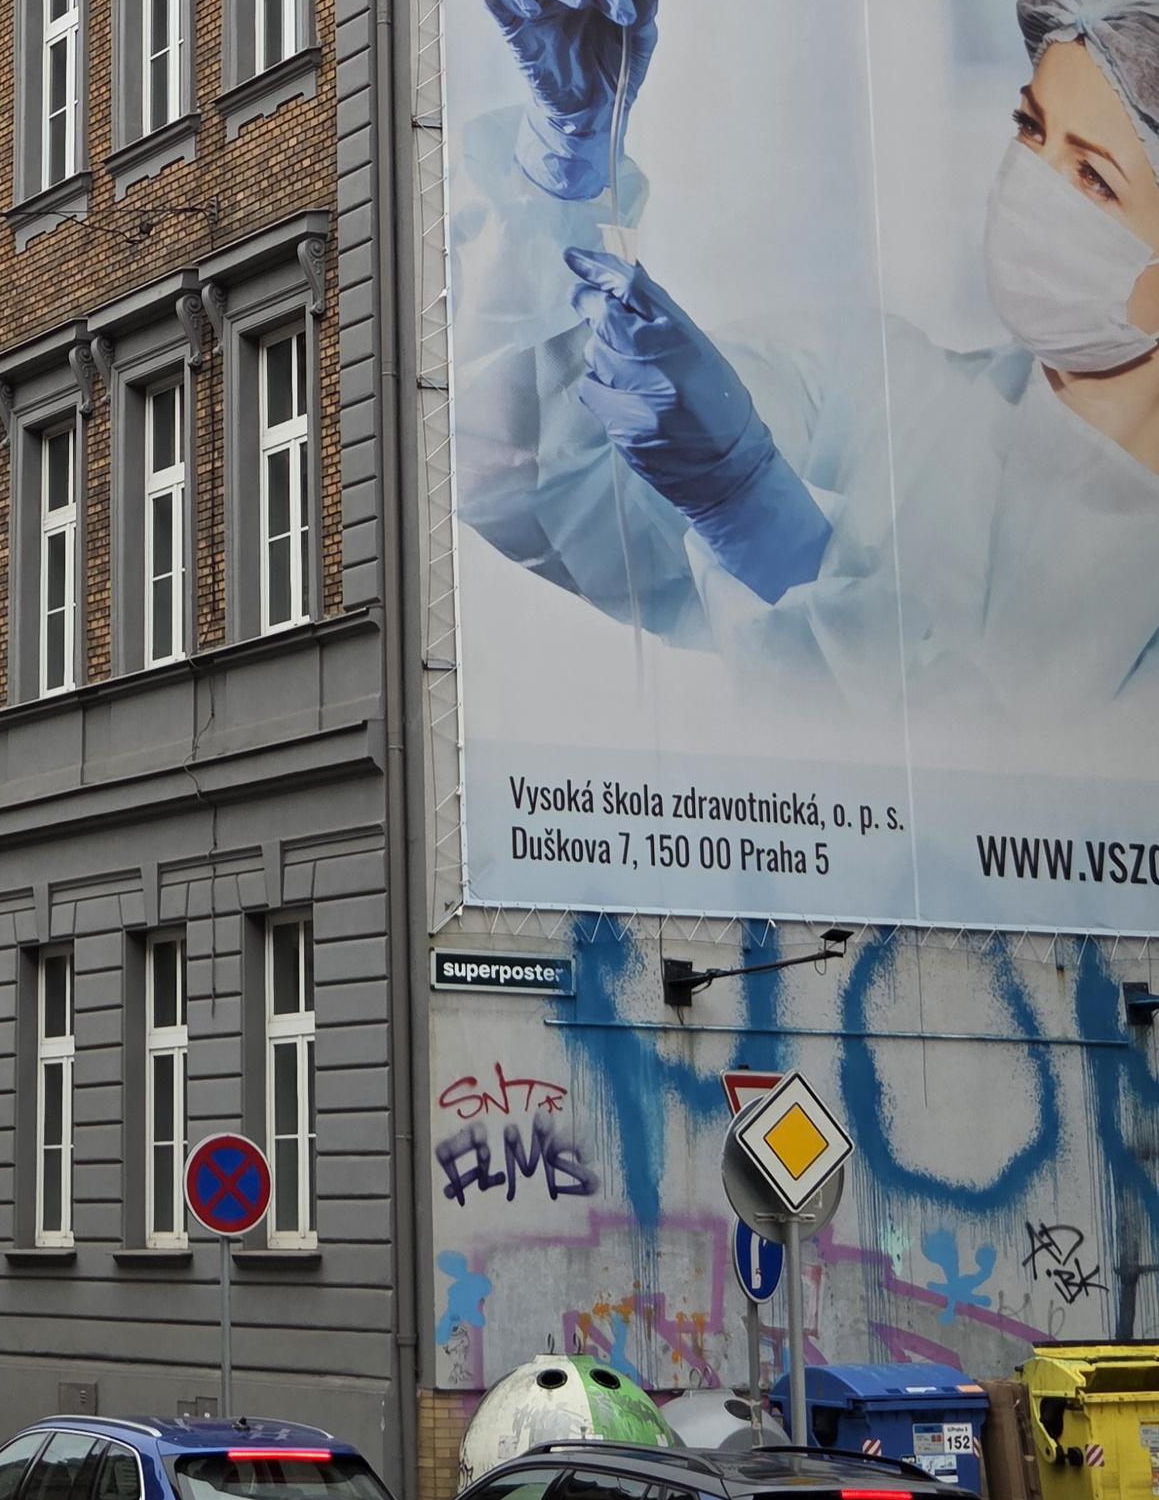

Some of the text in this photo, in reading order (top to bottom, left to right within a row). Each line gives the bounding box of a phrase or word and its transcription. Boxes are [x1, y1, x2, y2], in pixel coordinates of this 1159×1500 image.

[509, 776, 905, 835] Vysoká škola zdravotnická, o. p. s.
[511, 826, 830, 875] Duškova 7, 150 00 Praha 5
[443, 961, 563, 984] superposter
[947, 1434, 970, 1451] 152
